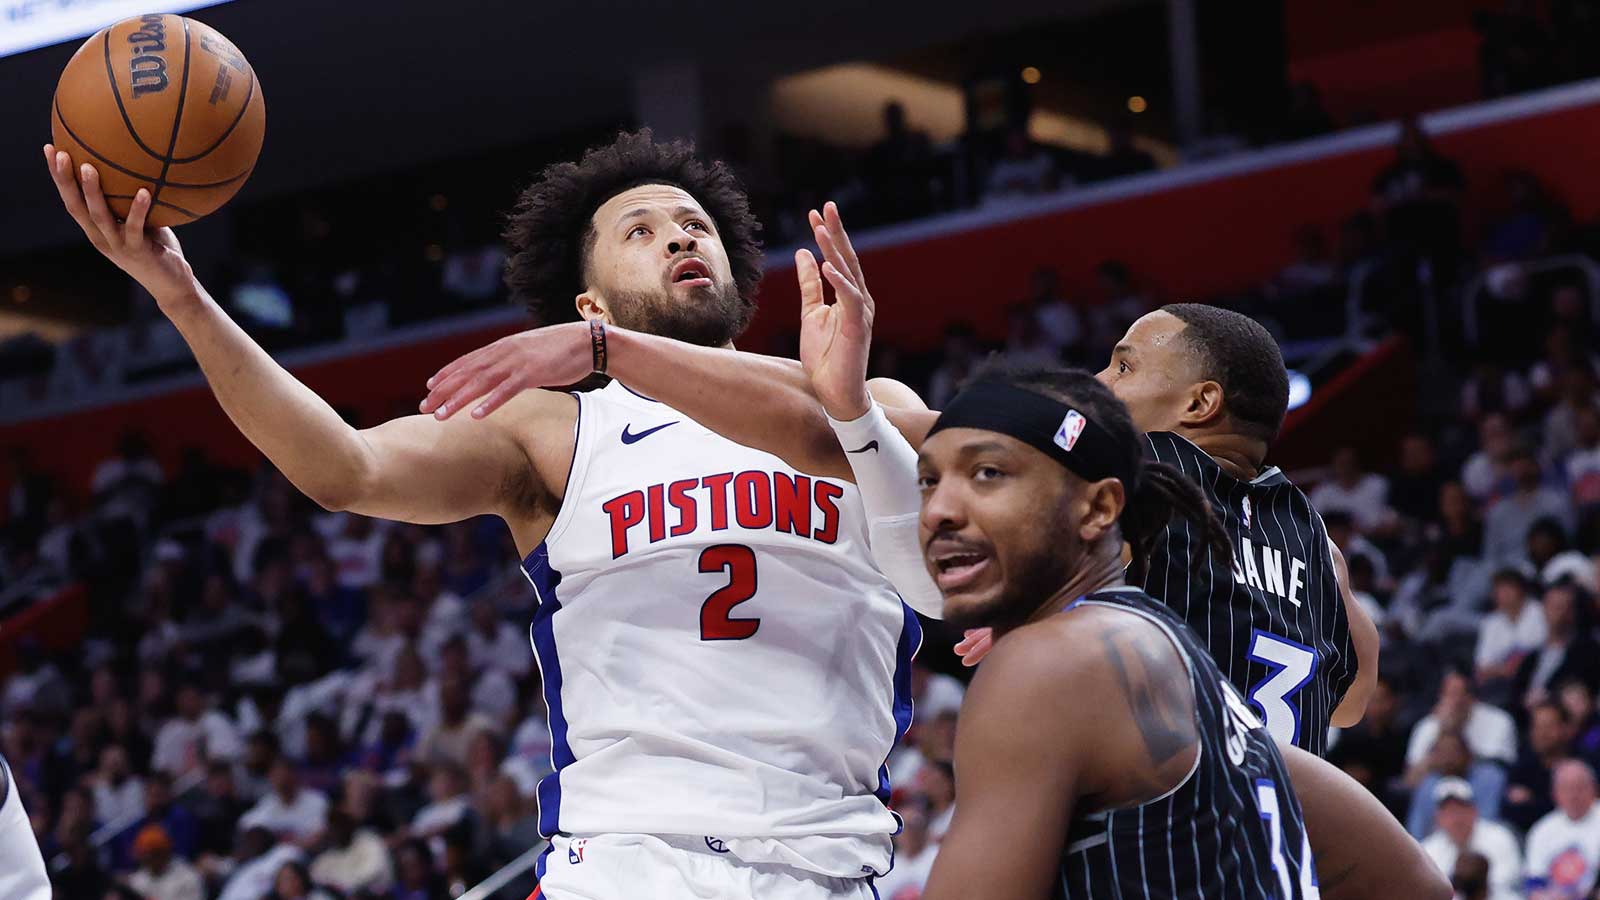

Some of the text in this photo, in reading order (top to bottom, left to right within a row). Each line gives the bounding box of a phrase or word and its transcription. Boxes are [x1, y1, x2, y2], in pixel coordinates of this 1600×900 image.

[127, 14, 170, 100] Wilso
[602, 470, 844, 560] PISTONS
[698, 543, 761, 641] 2
[1232, 536, 1306, 608] ANE
[1246, 628, 1318, 746] 3
